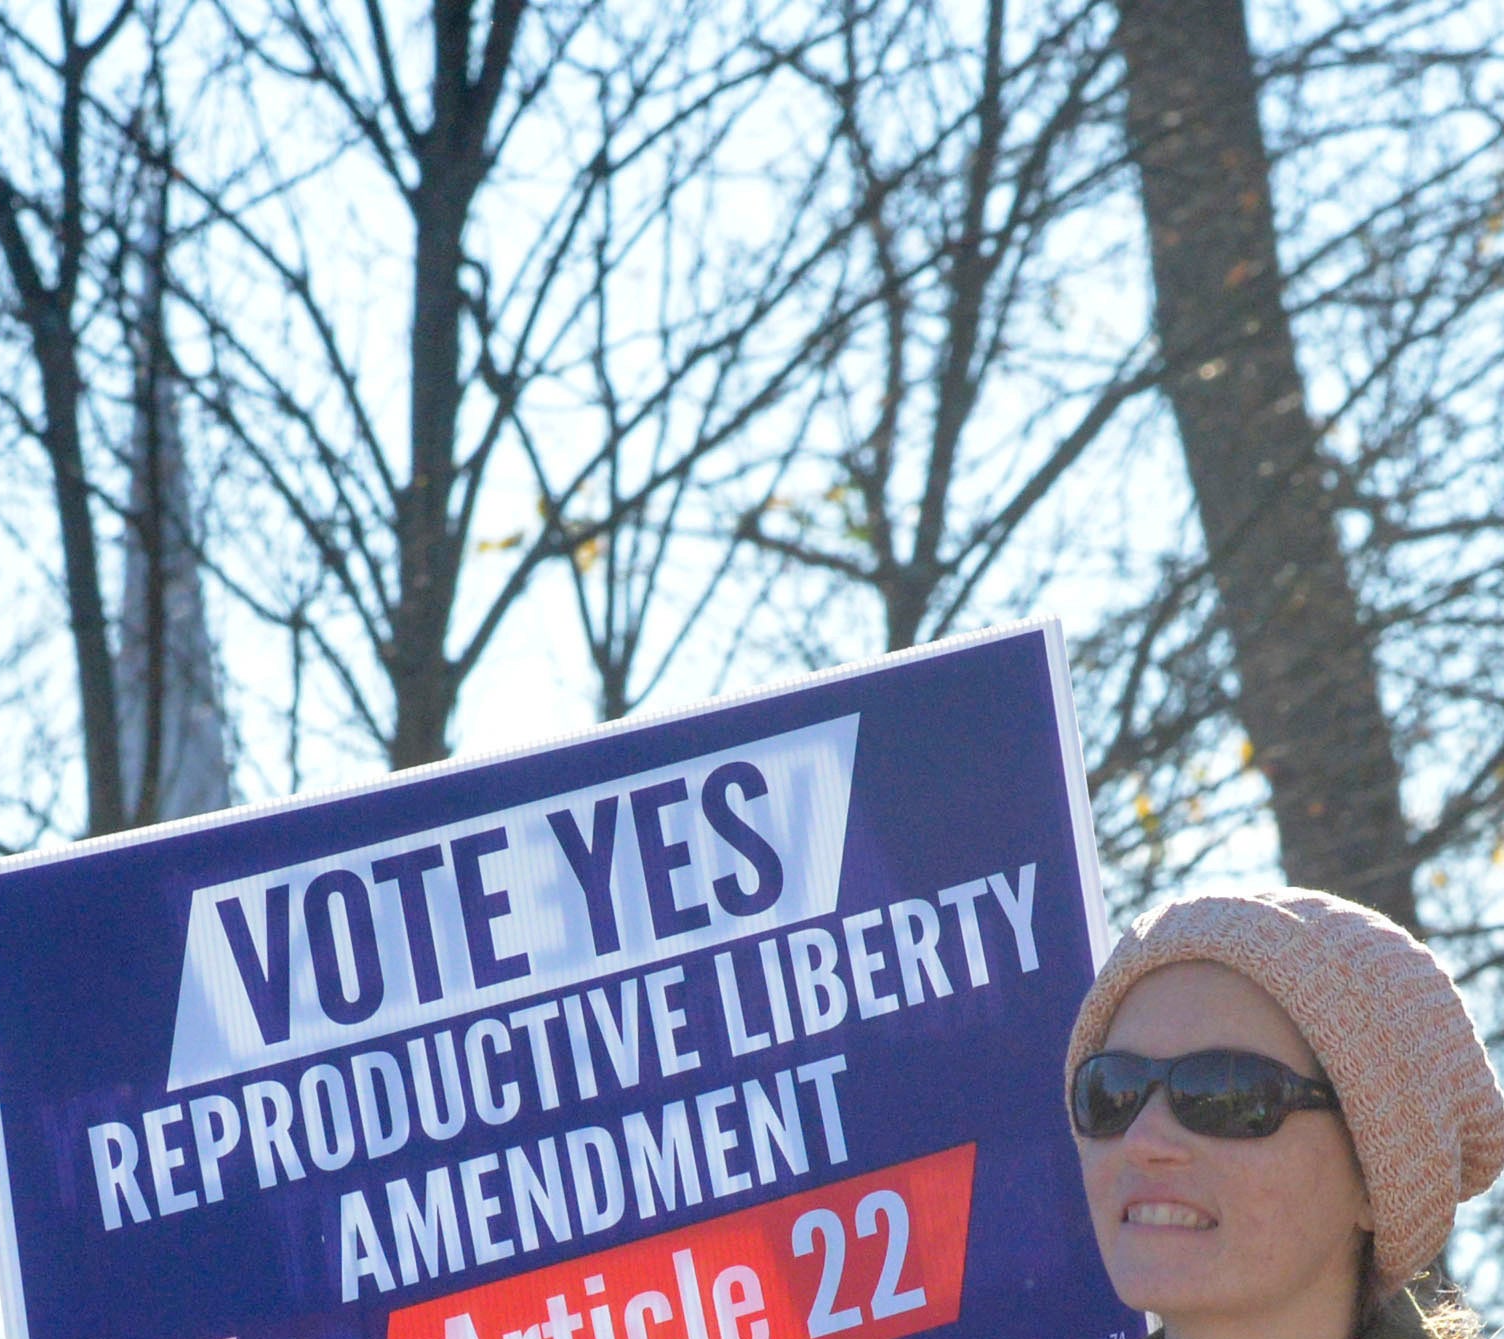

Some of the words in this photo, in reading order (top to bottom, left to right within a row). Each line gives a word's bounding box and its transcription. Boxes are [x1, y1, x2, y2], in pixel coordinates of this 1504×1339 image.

[216, 826, 532, 1045] VOTE
[546, 760, 785, 957] YES
[88, 966, 701, 1232] REPRODUCTIVE
[713, 861, 1041, 1056] LIBERTY
[339, 1054, 852, 1303] AMENDMENT
